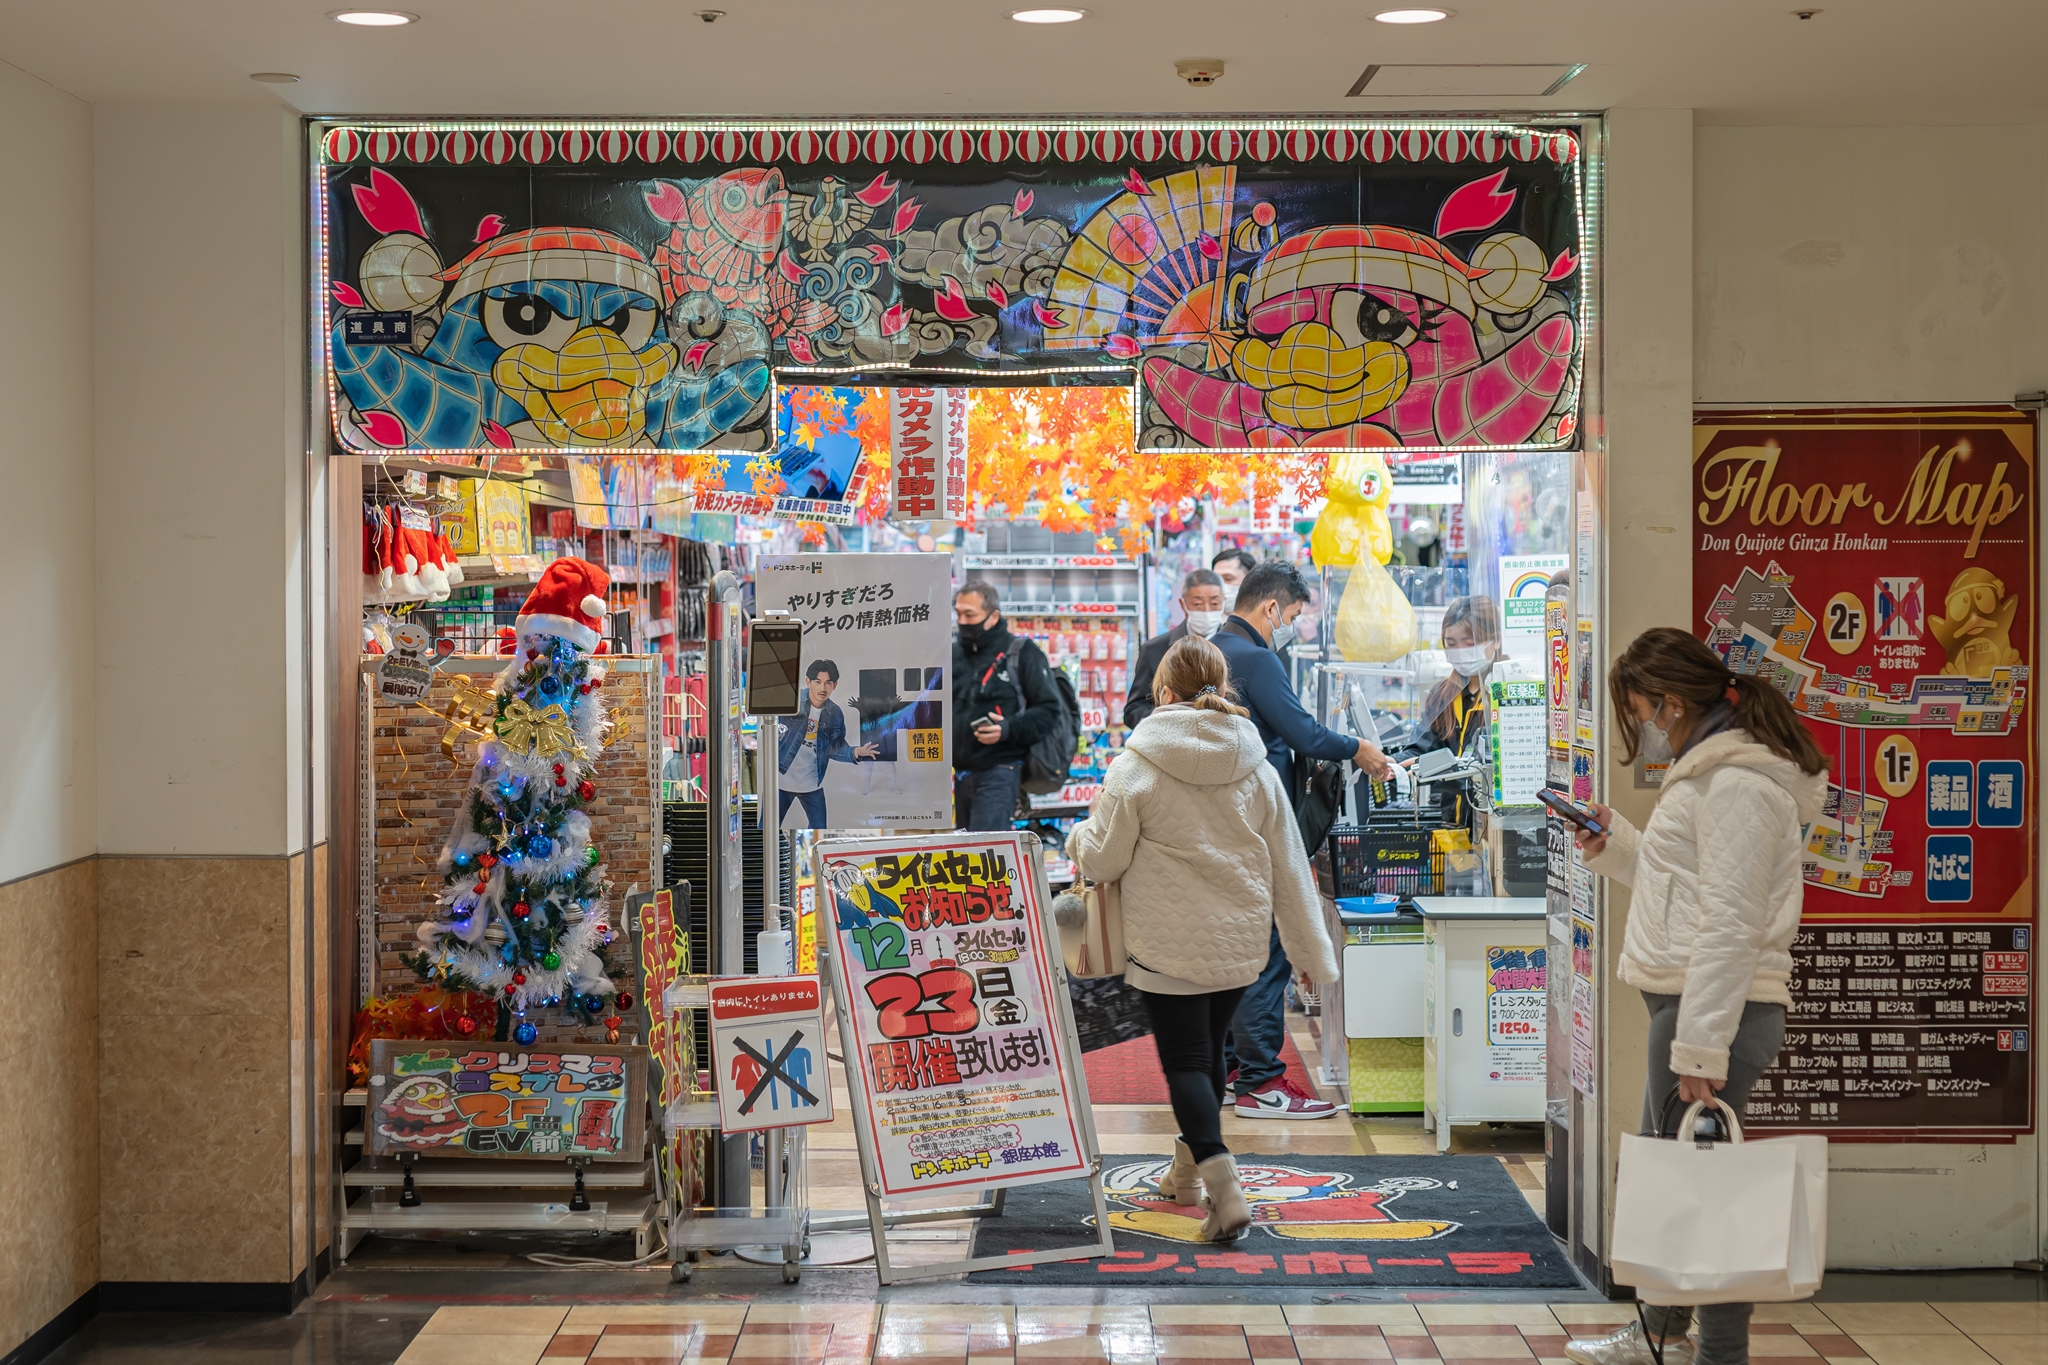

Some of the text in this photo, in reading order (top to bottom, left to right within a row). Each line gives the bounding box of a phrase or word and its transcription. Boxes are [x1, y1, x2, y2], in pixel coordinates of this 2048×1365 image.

[350, 321, 407, 333] 道具商
[1698, 444, 2024, 559] Floor Map
[1701, 533, 1888, 556] Don Quijote Ginza Honkan
[1504, 559, 1564, 569] 感染防止徹底宣言
[787, 583, 895, 612] やりすぎだろ
[1750, 593, 1775, 603] ブランド
[1772, 607, 1796, 617] ビジネス
[803, 604, 931, 636] ンキの情熱価格
[1829, 602, 1861, 641] 2F
[1782, 630, 1807, 641] シューズ
[1873, 645, 1926, 657] トイレは店内に
[1879, 657, 1919, 670] ありません
[1891, 684, 1907, 693] マスク
[1835, 702, 1870, 711] キャリーケース
[912, 733, 940, 745] 情熱
[912, 747, 940, 759] 価格
[1884, 744, 1911, 783] 1F
[1930, 775, 1969, 811] 薬品
[1987, 773, 2014, 809] 酒
[1928, 854, 1970, 881] たばこ
[1835, 932, 1890, 945] 家電・調理器具
[1906, 932, 1944, 944] 文具・工具
[1961, 932, 1991, 944] PC用品
[1793, 955, 1812, 967] ューズ
[1824, 955, 1851, 967] おもちゃ
[1863, 955, 1895, 967] コスプレ
[1914, 955, 1945, 967] 電子タバコ
[1786, 978, 1972, 991] スク お土産 理美容家電 バラエティグッズ
[717, 990, 814, 1008] 店内にトイレありません
[1796, 1001, 2026, 1013] イヤホン 大工用品 ビジネス 化粧品 キャリーケース
[1821, 1033, 1859, 1045] ペット用品
[1880, 1033, 1905, 1045] 冷蔵品
[1929, 1033, 1995, 1045] ガム・キャンディー
[457, 1051, 625, 1074] クリスマス
[1799, 1056, 1838, 1068] カップめん
[1852, 1056, 1868, 1068] お酒
[1926, 1056, 1950, 1068] 化粧品
[1752, 1079, 1990, 1092] 用品 スポーツ用品 レディースインナー メンズインナー
[451, 1093, 551, 1128] 2F
[1745, 1102, 1801, 1115] 節衣料・ベルト
